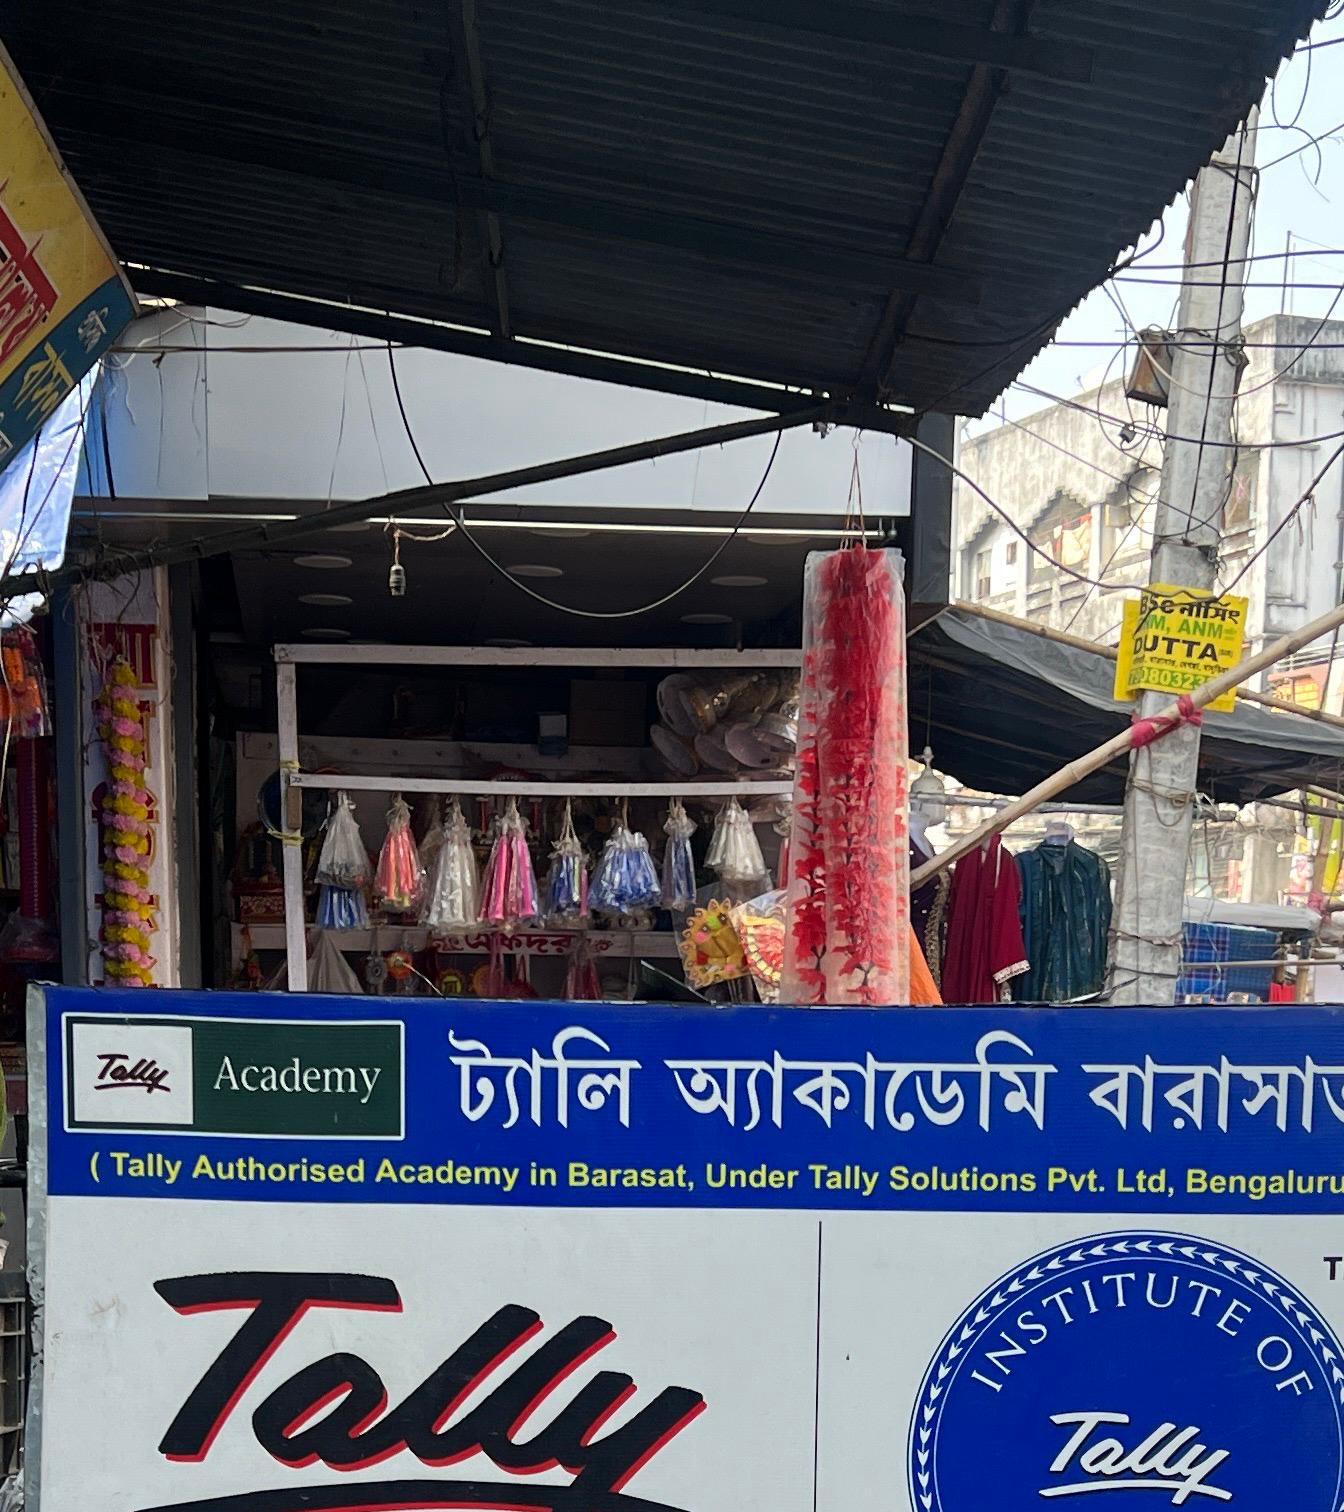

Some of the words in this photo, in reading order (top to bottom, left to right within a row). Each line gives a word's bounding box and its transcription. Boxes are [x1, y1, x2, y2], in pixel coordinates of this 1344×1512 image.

[94, 1053, 172, 1094] Tally
[213, 1054, 382, 1104] Academy
[447, 1025, 643, 1129] ট্যালি
[663, 1029, 1059, 1133] অ্যাকাডেমি
[109, 1151, 183, 1184] Tally
[191, 1155, 366, 1184] Authorised
[374, 1158, 519, 1193] Academy
[528, 1161, 558, 1188] in
[567, 1162, 695, 1193] Barasat,
[705, 1163, 800, 1190] Under
[807, 1163, 880, 1196] Tally
[888, 1164, 1037, 1193] Solutions
[1046, 1166, 1107, 1195] Pvt.
[1115, 1167, 1175, 1199] Ltd,
[969, 1270, 1254, 1395] INSTITUTE
[1256, 1335, 1315, 1401] OF
[1037, 1411, 1234, 1506] Tally
